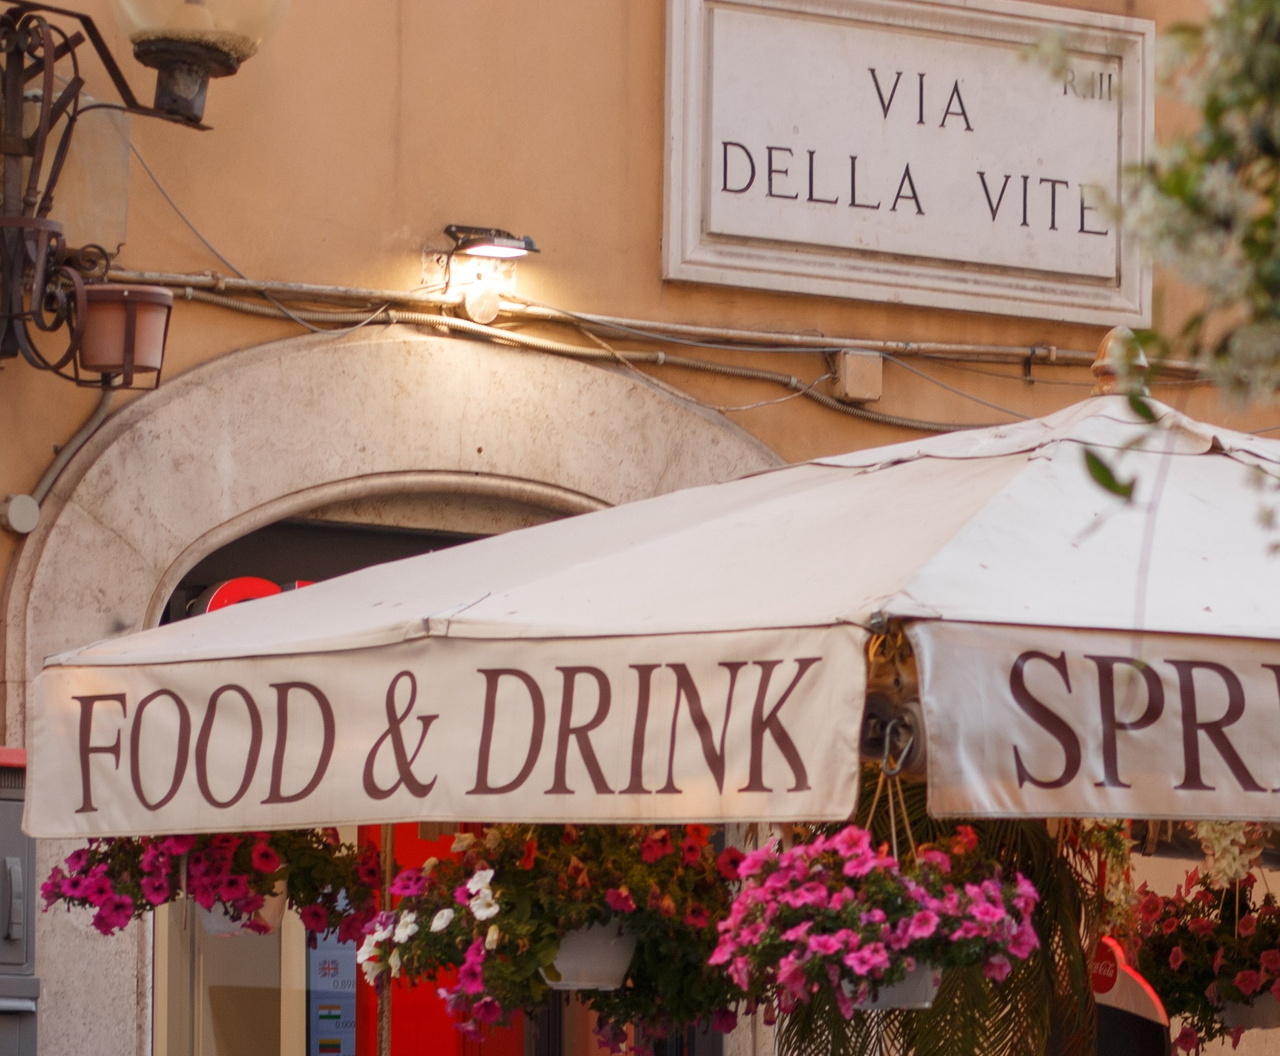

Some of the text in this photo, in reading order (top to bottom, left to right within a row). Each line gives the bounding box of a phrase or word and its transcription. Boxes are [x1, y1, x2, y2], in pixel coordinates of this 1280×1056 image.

[868, 67, 974, 132] VIA
[721, 141, 1109, 236] DELLA VITE
[72, 656, 823, 813] FOOD & DRINK
